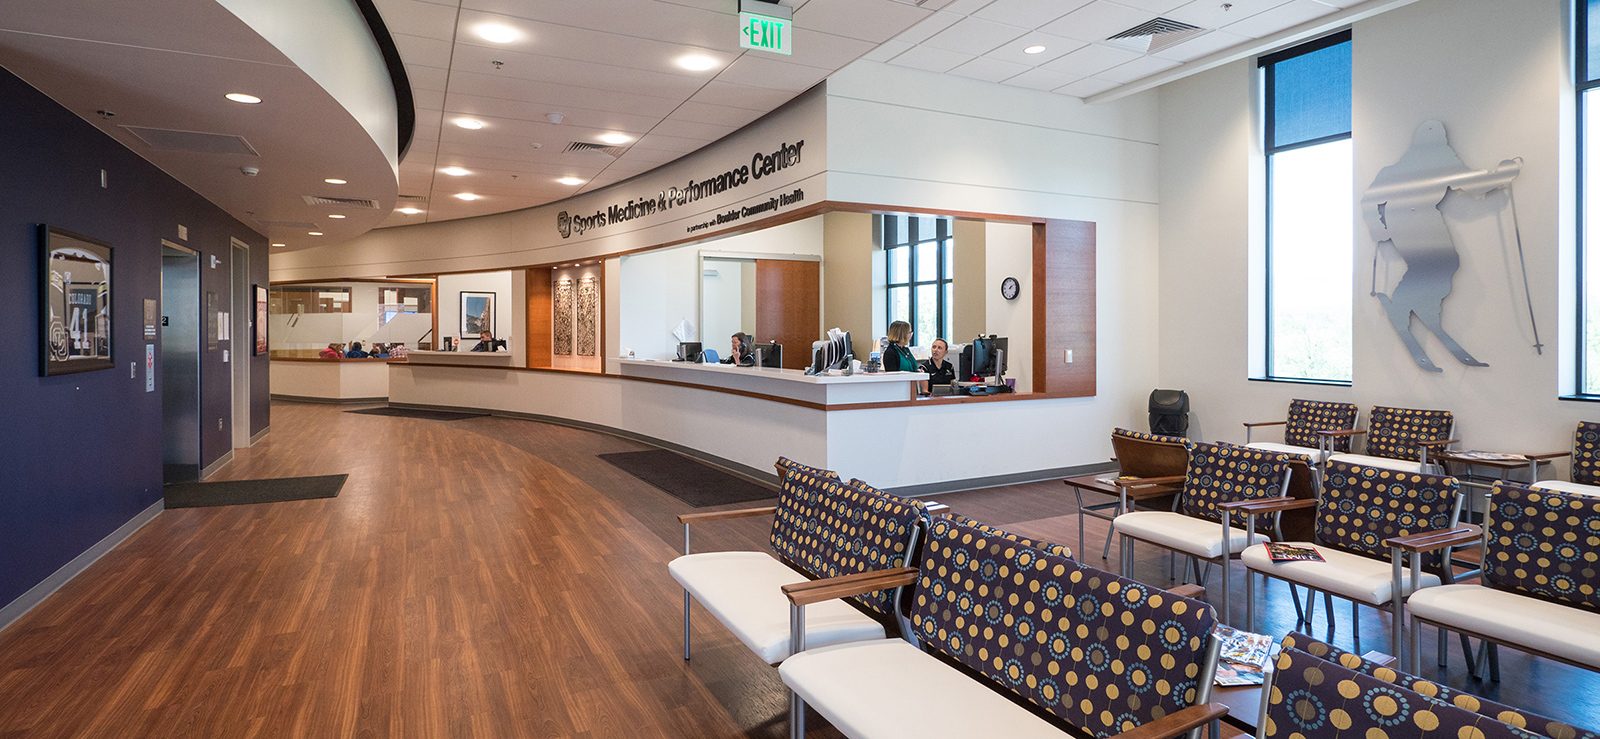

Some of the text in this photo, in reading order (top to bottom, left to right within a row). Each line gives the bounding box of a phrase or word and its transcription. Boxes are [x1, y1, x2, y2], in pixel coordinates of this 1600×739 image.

[750, 17, 784, 50] EXIT
[573, 210, 607, 236] Sports
[608, 197, 656, 225] Medicine
[657, 190, 667, 212] &
[668, 165, 749, 209] Performance
[752, 139, 804, 180] Center
[690, 221, 709, 233] partnership
[709, 219, 717, 227] with
[716, 210, 741, 225] Boulder
[741, 197, 779, 218] Community
[779, 188, 804, 207] Health
[68, 293, 92, 305] COLORADO
[69, 307, 90, 349] 41
[162, 316, 167, 324] 2
